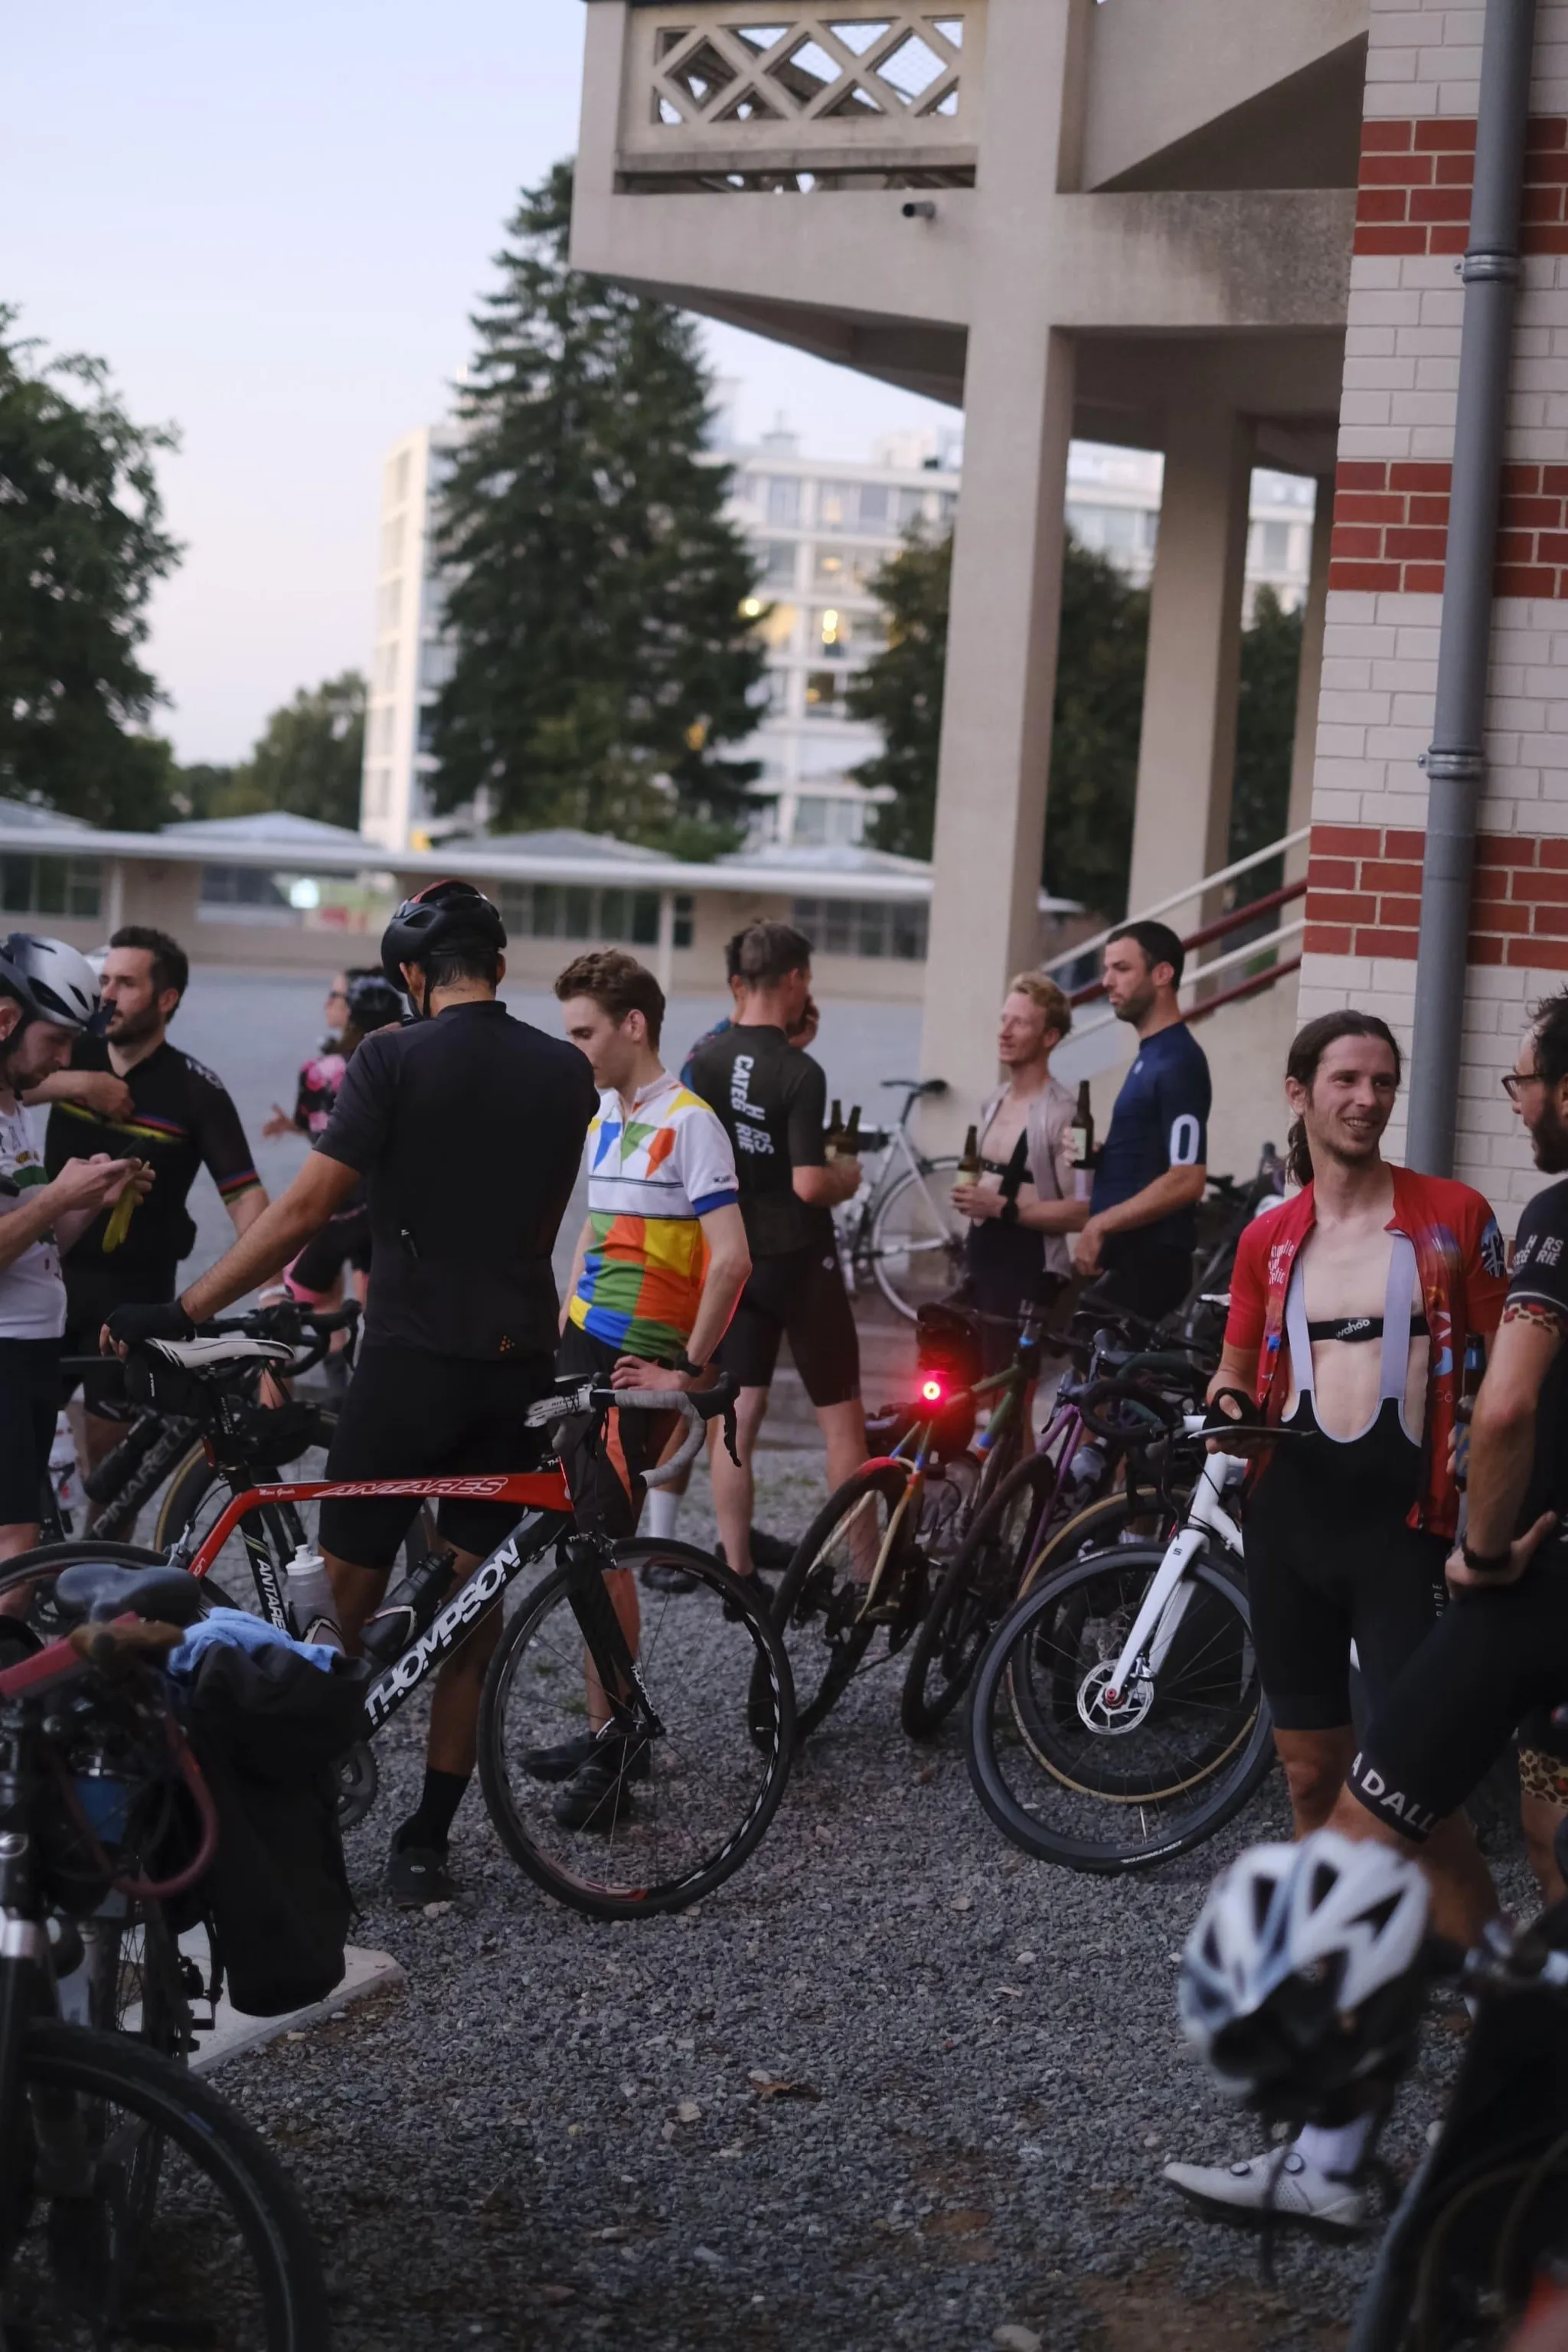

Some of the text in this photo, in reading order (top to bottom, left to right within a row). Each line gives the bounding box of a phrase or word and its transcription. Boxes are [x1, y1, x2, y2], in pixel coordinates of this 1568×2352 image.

[1334, 1318, 1371, 1338] wahoo
[312, 1477, 508, 1498] ANTARES
[256, 1558, 287, 1631] ANTARE
[364, 1537, 521, 1726] THOMPSON
